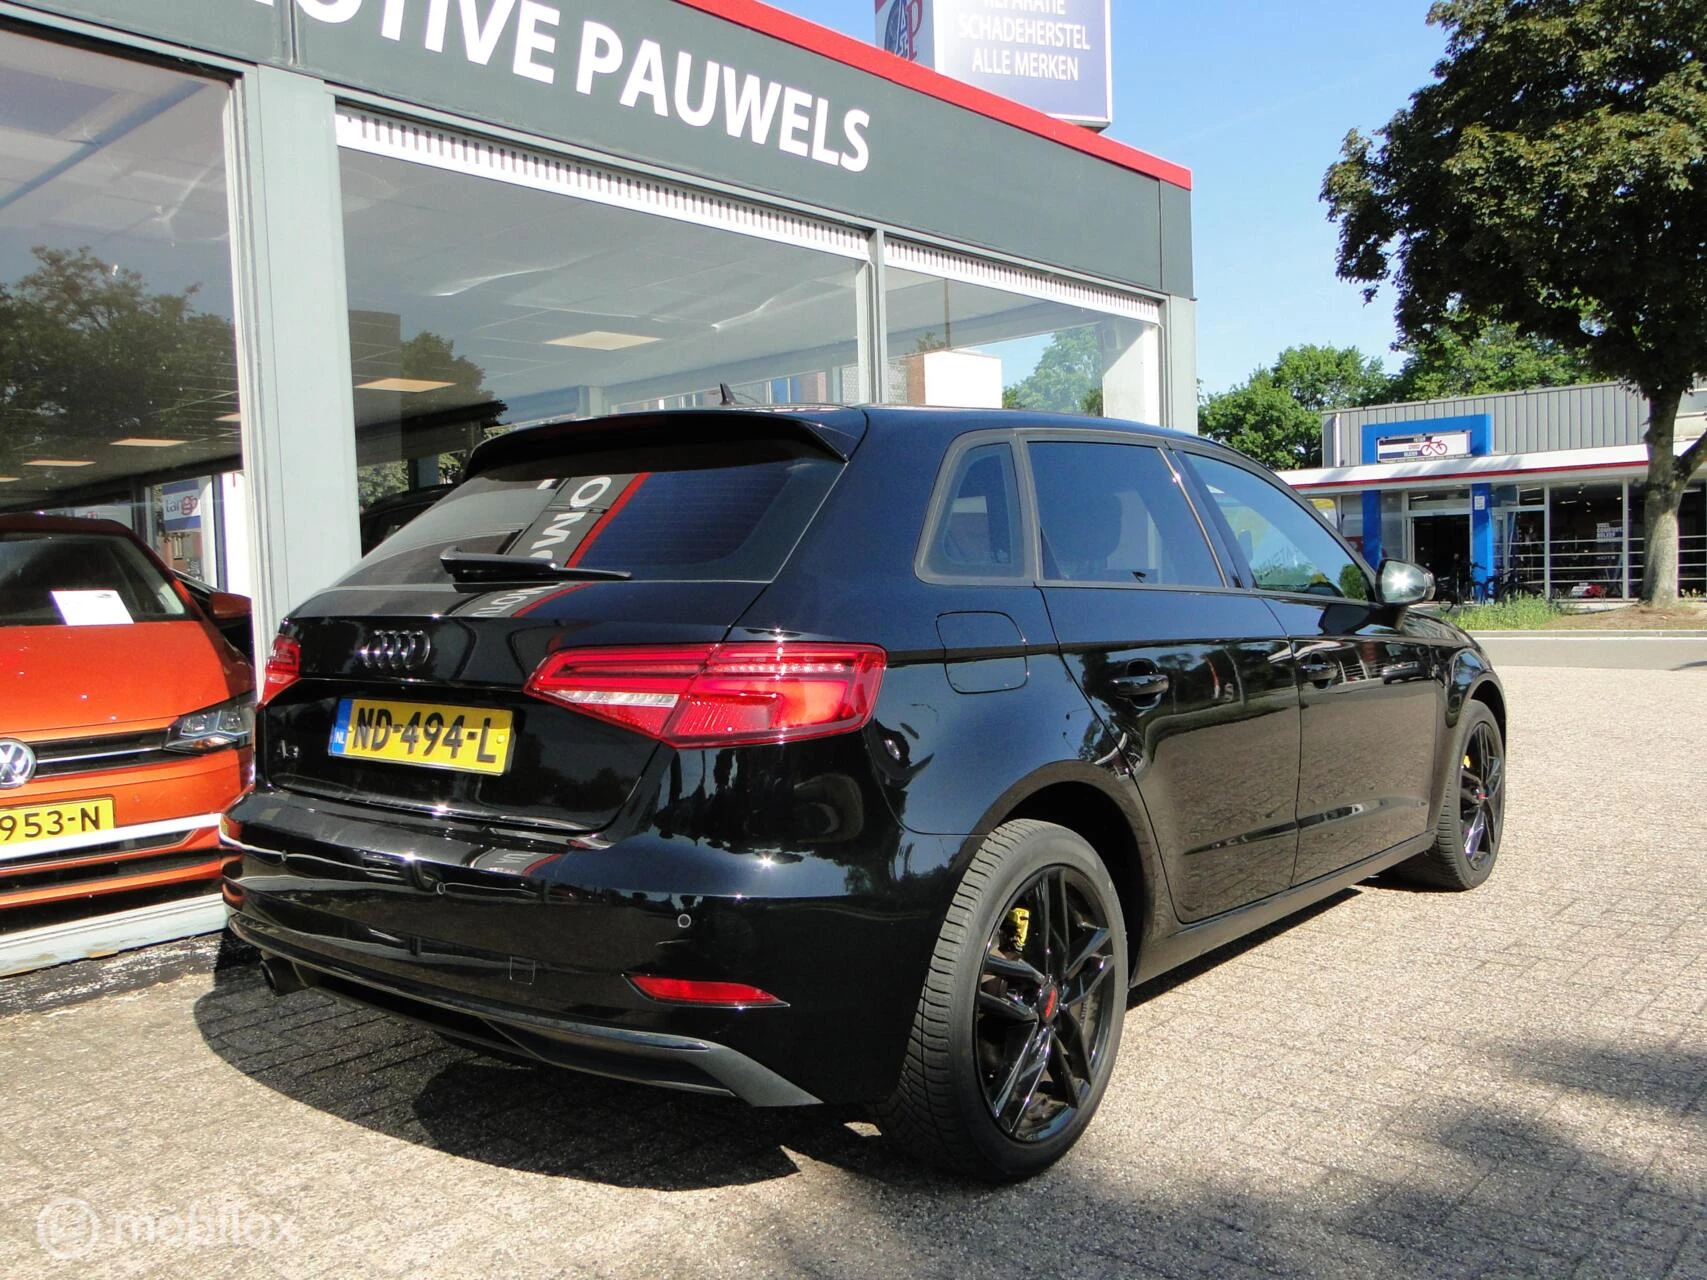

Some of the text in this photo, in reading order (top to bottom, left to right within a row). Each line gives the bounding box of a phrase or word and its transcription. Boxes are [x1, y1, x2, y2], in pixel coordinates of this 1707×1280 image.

[959, 13, 1091, 50] SCHADEHERSTEL
[972, 47, 1079, 81] ALLE MERKEN
[248, 0, 870, 172] TIVE PAUWELS
[335, 731, 345, 744] NL
[352, 708, 497, 763] ND-494-L
[0, 806, 101, 841] 953-N
